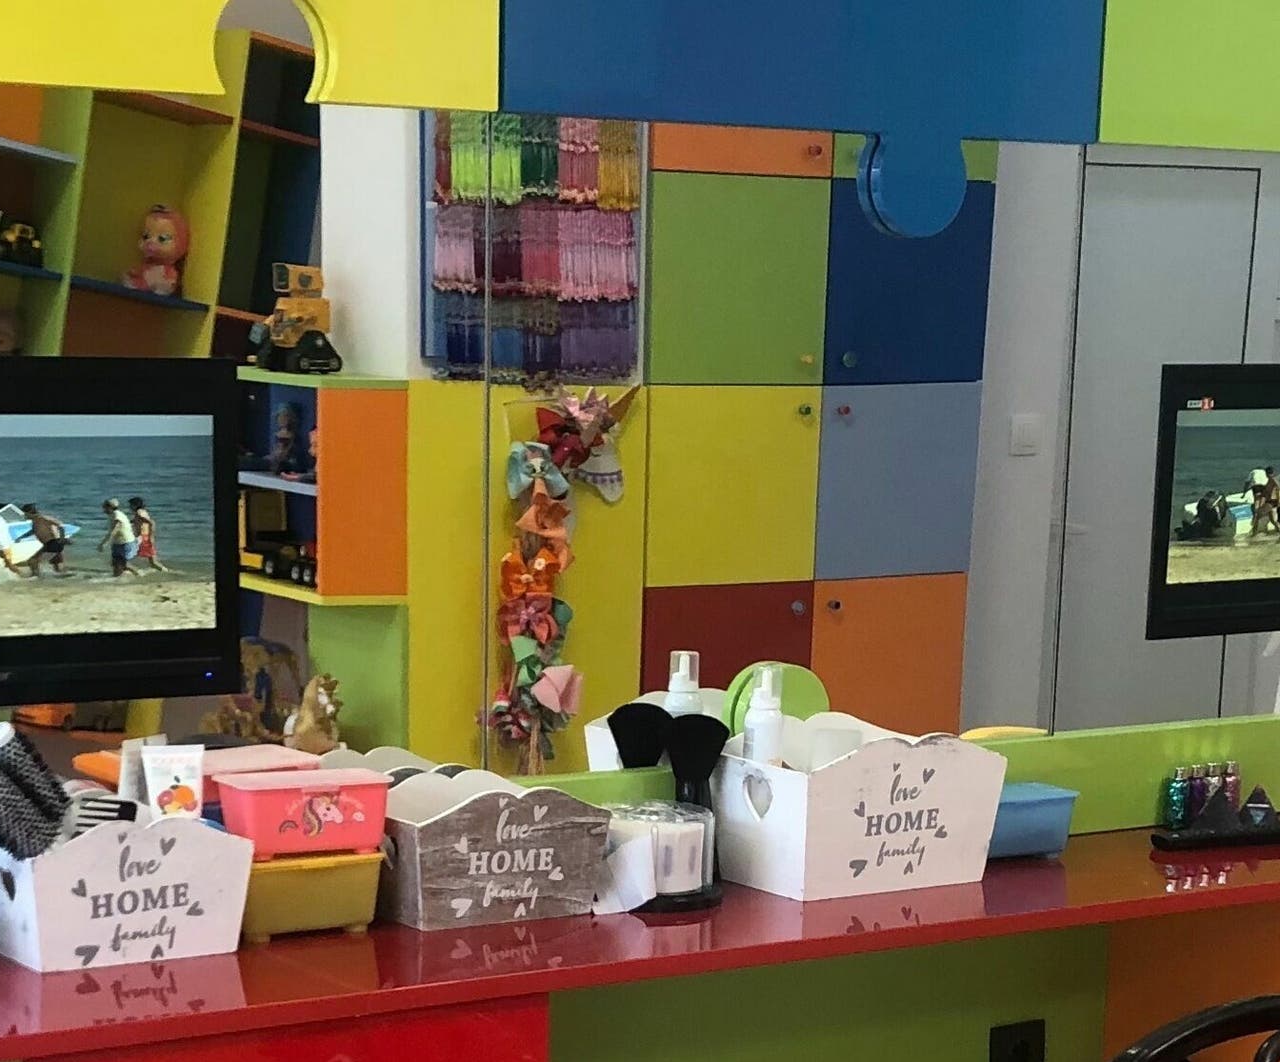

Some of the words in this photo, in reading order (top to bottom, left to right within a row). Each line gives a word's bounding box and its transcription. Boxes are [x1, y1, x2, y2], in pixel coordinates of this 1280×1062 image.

[890, 773, 921, 805] love
[496, 806, 531, 844] love
[865, 808, 939, 837] HOME
[118, 845, 161, 882] love
[467, 847, 554, 875] HOME
[876, 836, 926, 867] family
[90, 882, 190, 919] HOME
[482, 877, 539, 909] family
[110, 915, 176, 952] family
